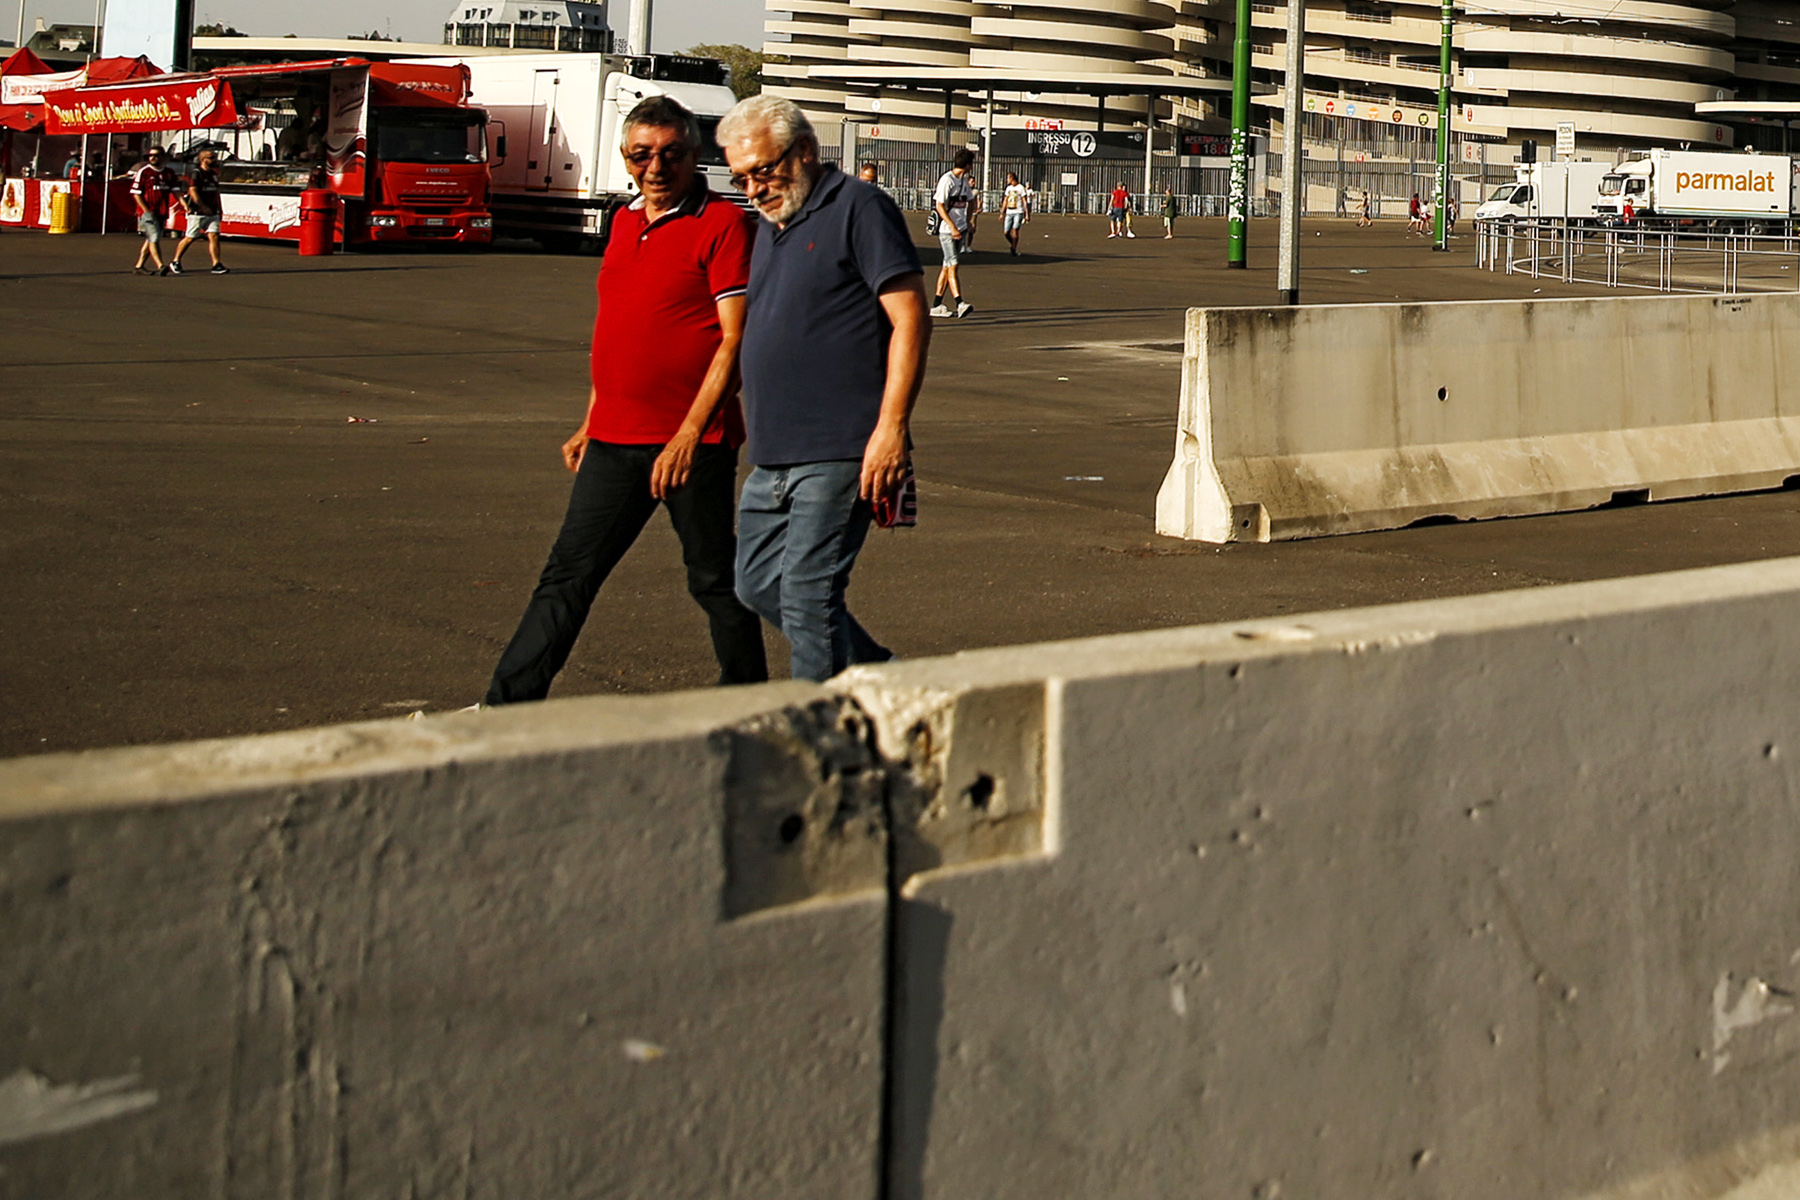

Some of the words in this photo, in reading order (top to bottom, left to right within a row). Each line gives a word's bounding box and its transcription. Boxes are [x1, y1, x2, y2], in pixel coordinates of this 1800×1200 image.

[81, 101, 106, 126] Sport
[1027, 132, 1071, 145] INGRESSO
[1075, 135, 1092, 153] 12
[1039, 143, 1059, 154] GATE
[1203, 144, 1230, 155] 18:4
[1676, 169, 1775, 193] parmalat
